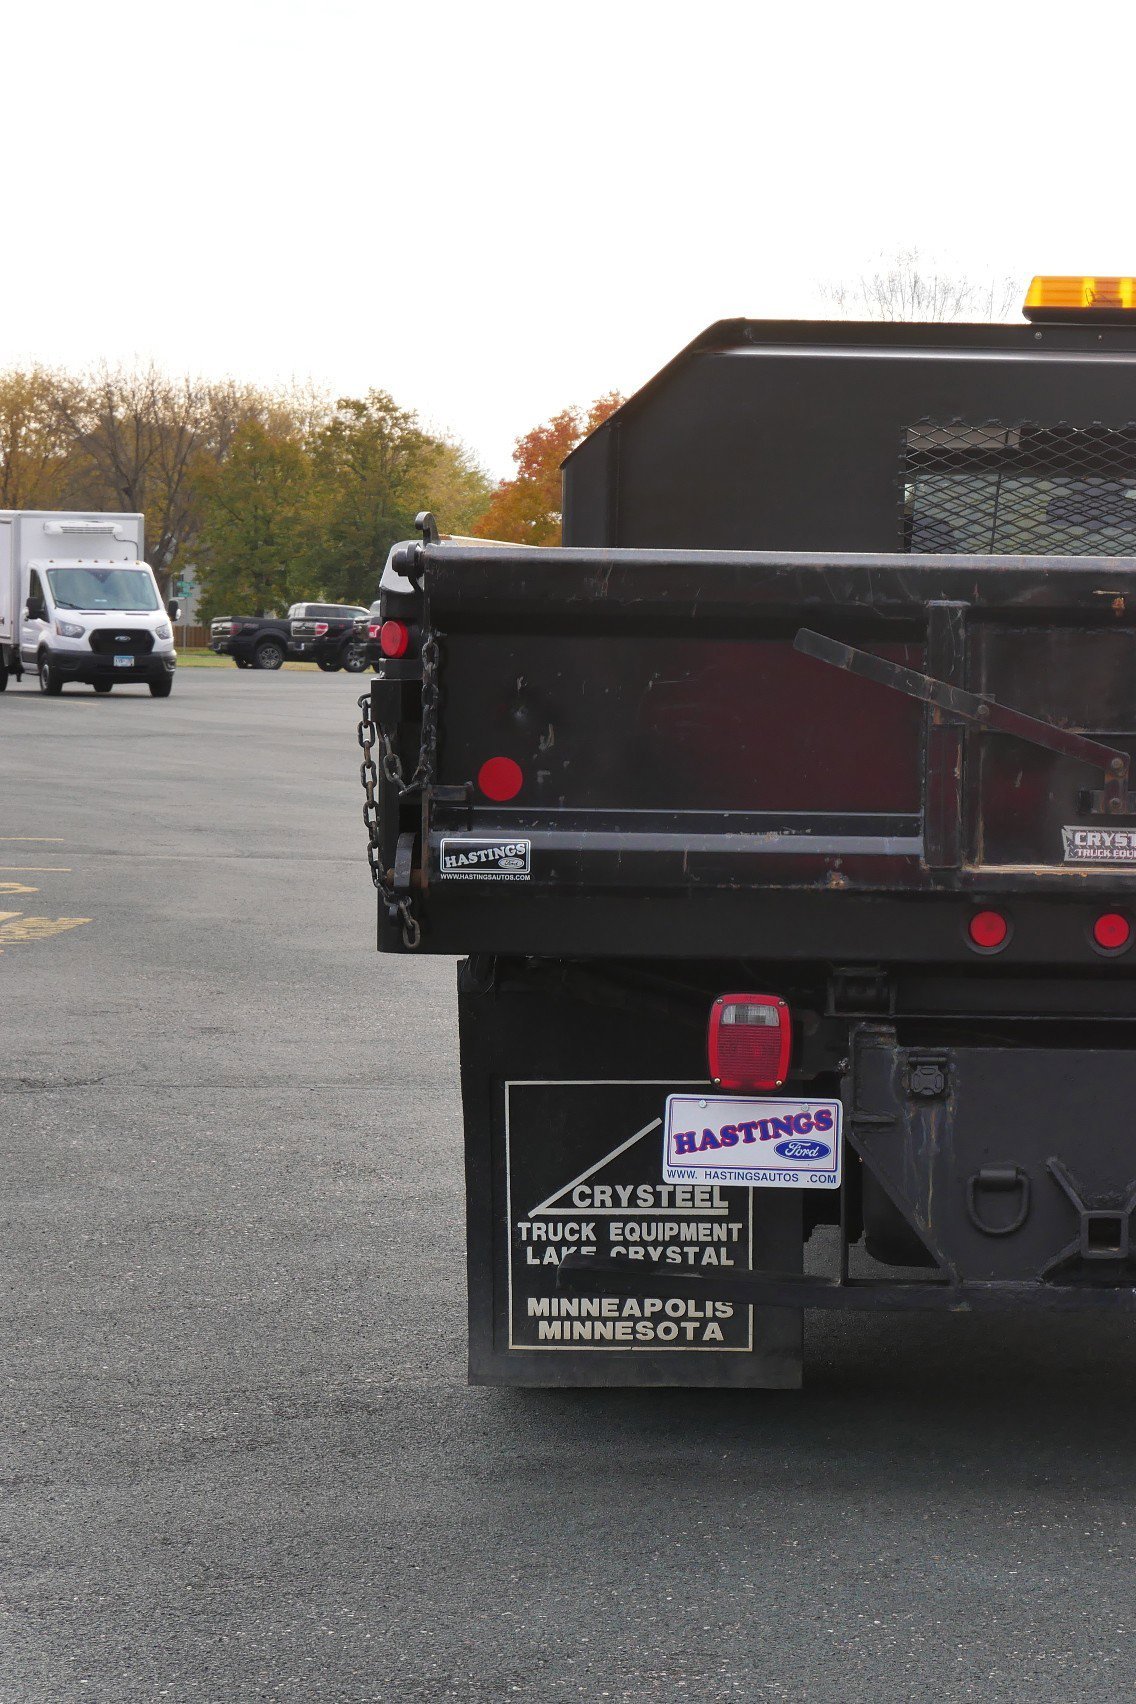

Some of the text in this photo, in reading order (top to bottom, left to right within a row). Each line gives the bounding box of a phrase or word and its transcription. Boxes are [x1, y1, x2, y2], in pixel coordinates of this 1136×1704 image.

[444, 843, 526, 867] HASTINGS
[1076, 848, 1111, 858] TRUCK
[673, 1109, 834, 1155] HASTINGS
[784, 1142, 819, 1157] Ford
[667, 1170, 698, 1179] WWW.
[704, 1171, 799, 1182] HASTINGSAUTOS
[572, 1185, 729, 1208] CRYSTEEL
[517, 1222, 743, 1242] TRUCK EQUIPMENT
[527, 1298, 734, 1318] MINNEAPOLIS
[538, 1321, 724, 1341] MINNESOTA
